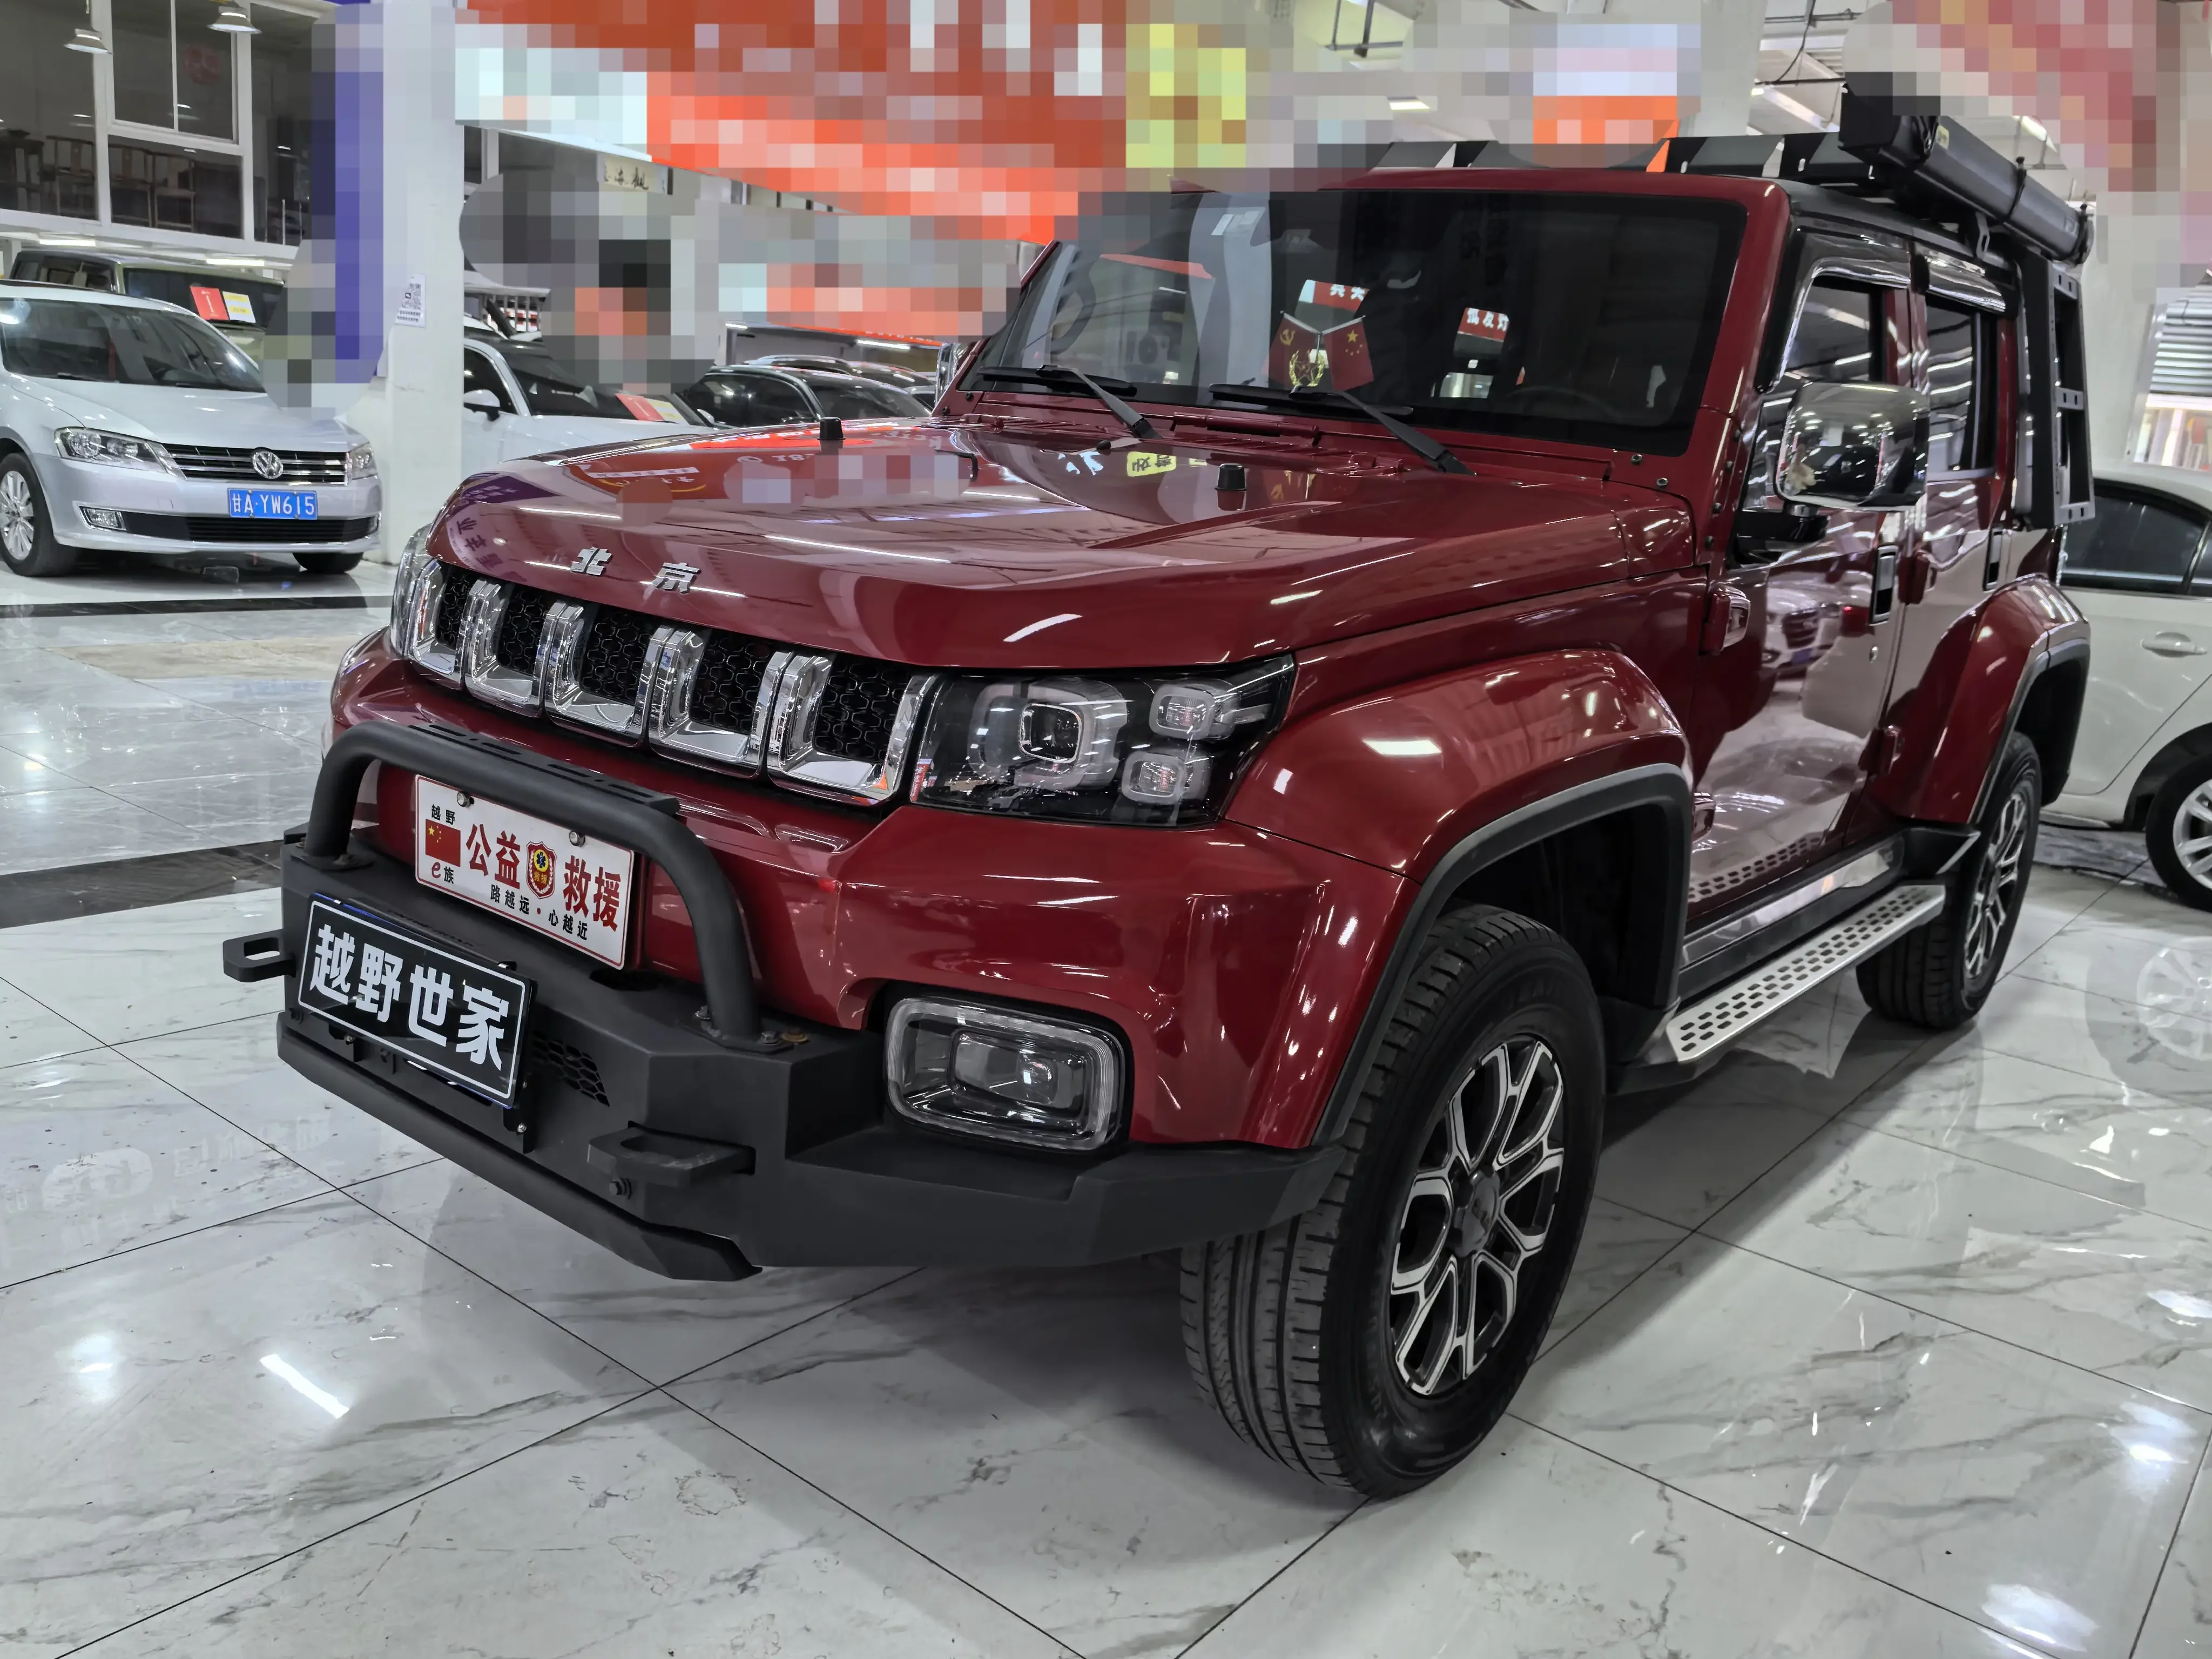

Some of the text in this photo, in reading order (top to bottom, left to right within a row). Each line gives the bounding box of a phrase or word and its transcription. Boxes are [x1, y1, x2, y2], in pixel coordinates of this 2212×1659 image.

[570, 547, 700, 594] 北京
[431, 804, 455, 825] 越野
[466, 824, 622, 932] 公益 救援
[309, 923, 509, 1071] 越野世家
